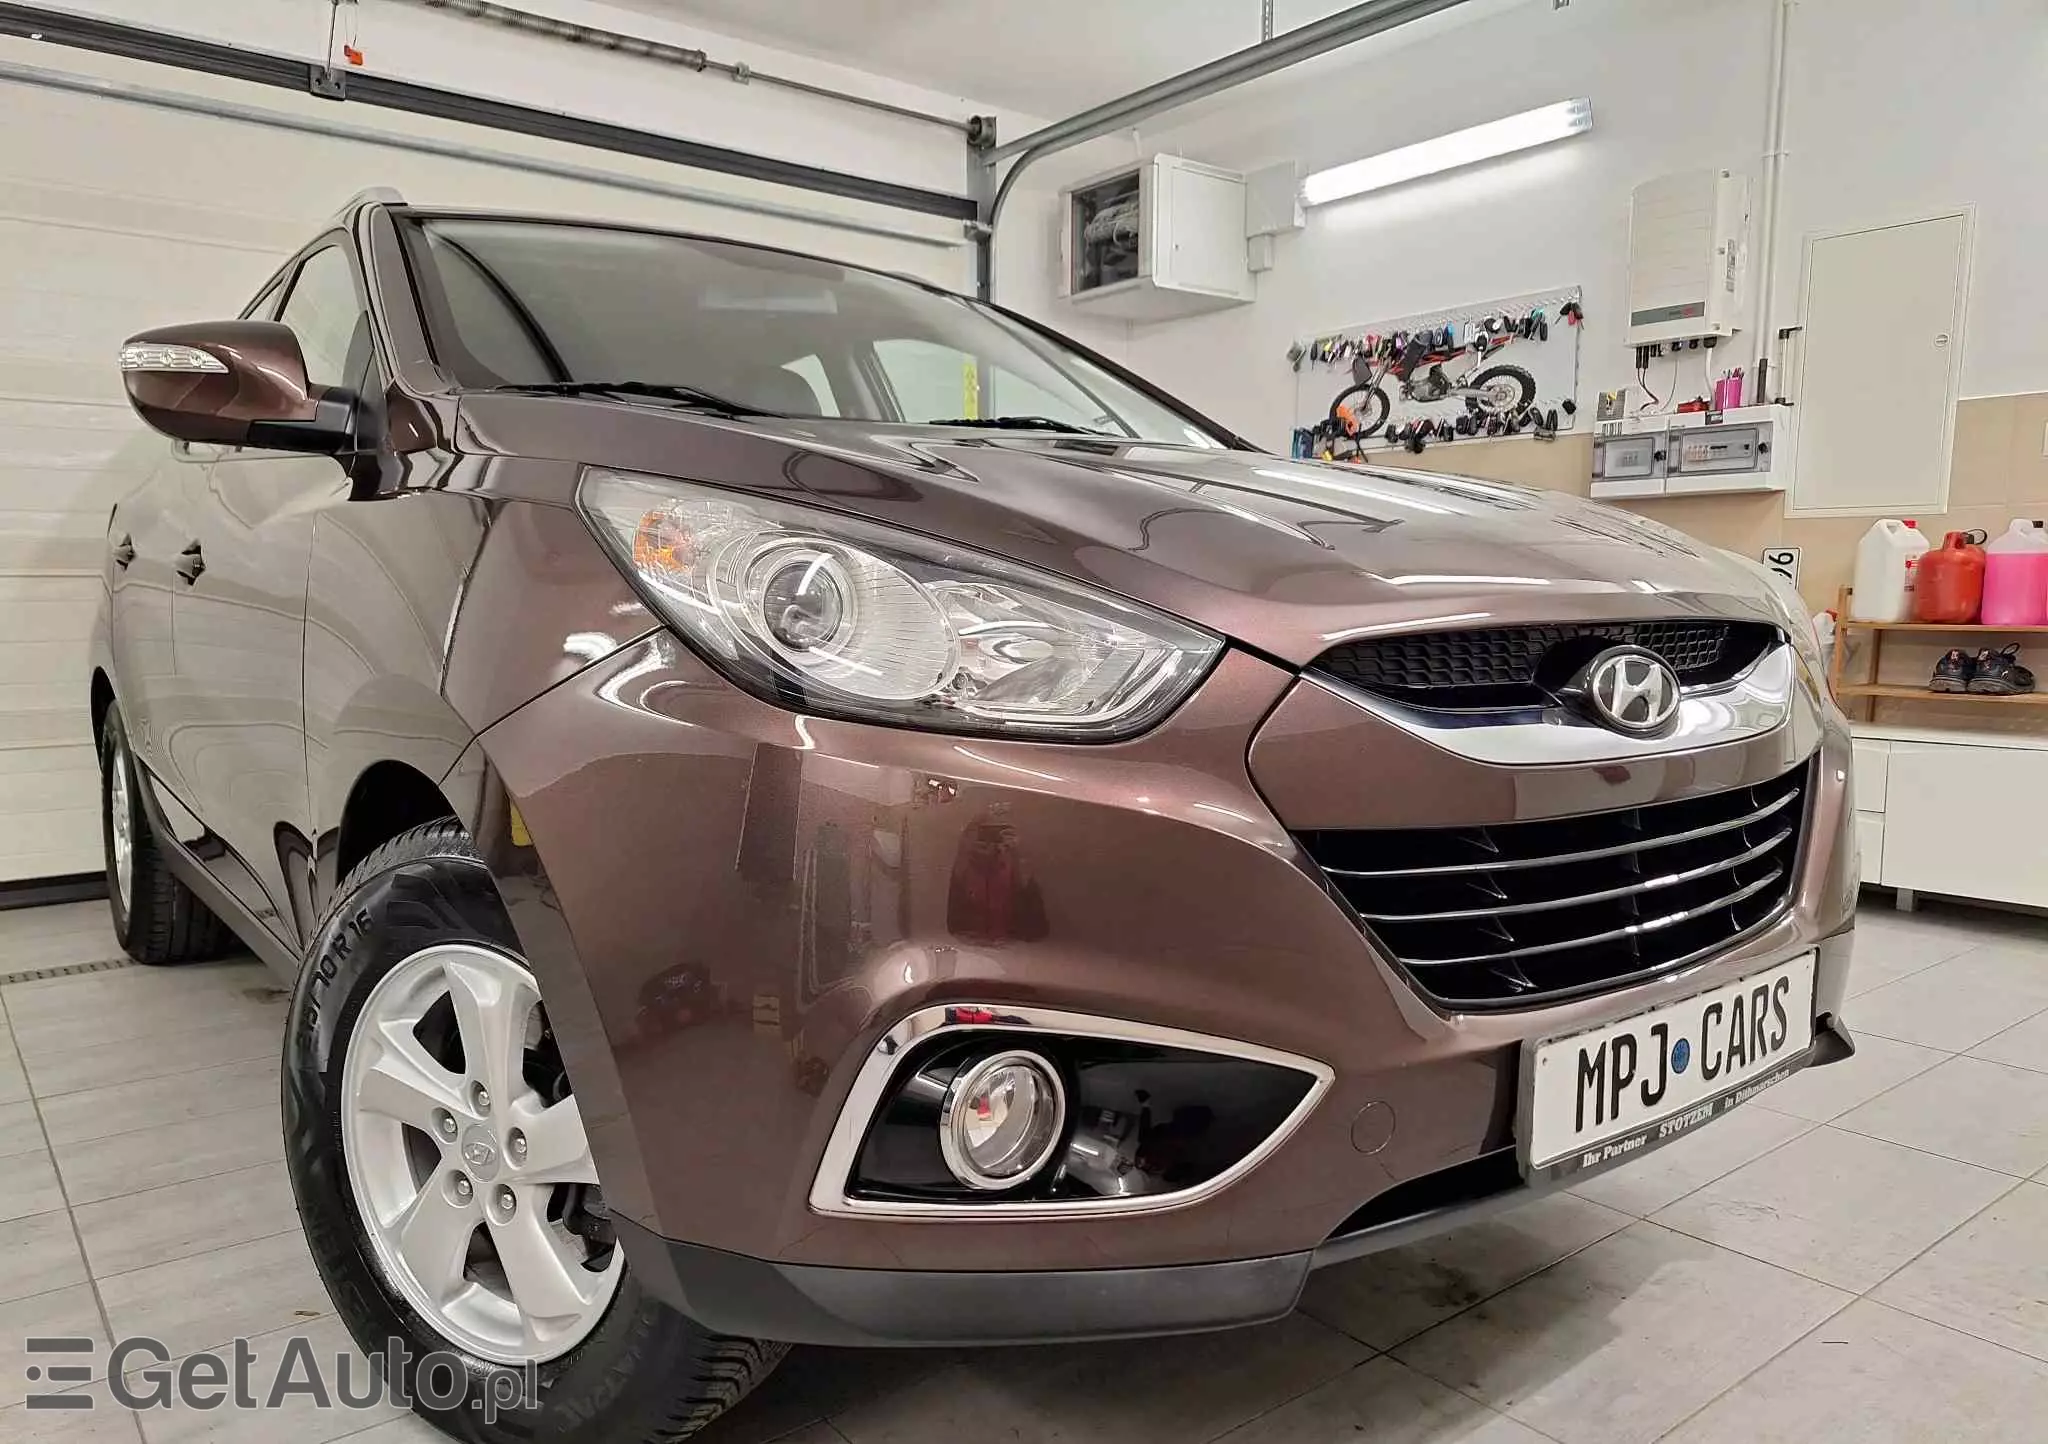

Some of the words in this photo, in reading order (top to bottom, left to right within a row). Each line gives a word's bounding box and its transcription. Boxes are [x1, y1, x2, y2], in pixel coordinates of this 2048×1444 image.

[1575, 1022, 1669, 1133] MPJ
[1701, 975, 1790, 1081] CARS
[1582, 1150, 1602, 1168] Ihr
[1603, 1134, 1648, 1160] Partner
